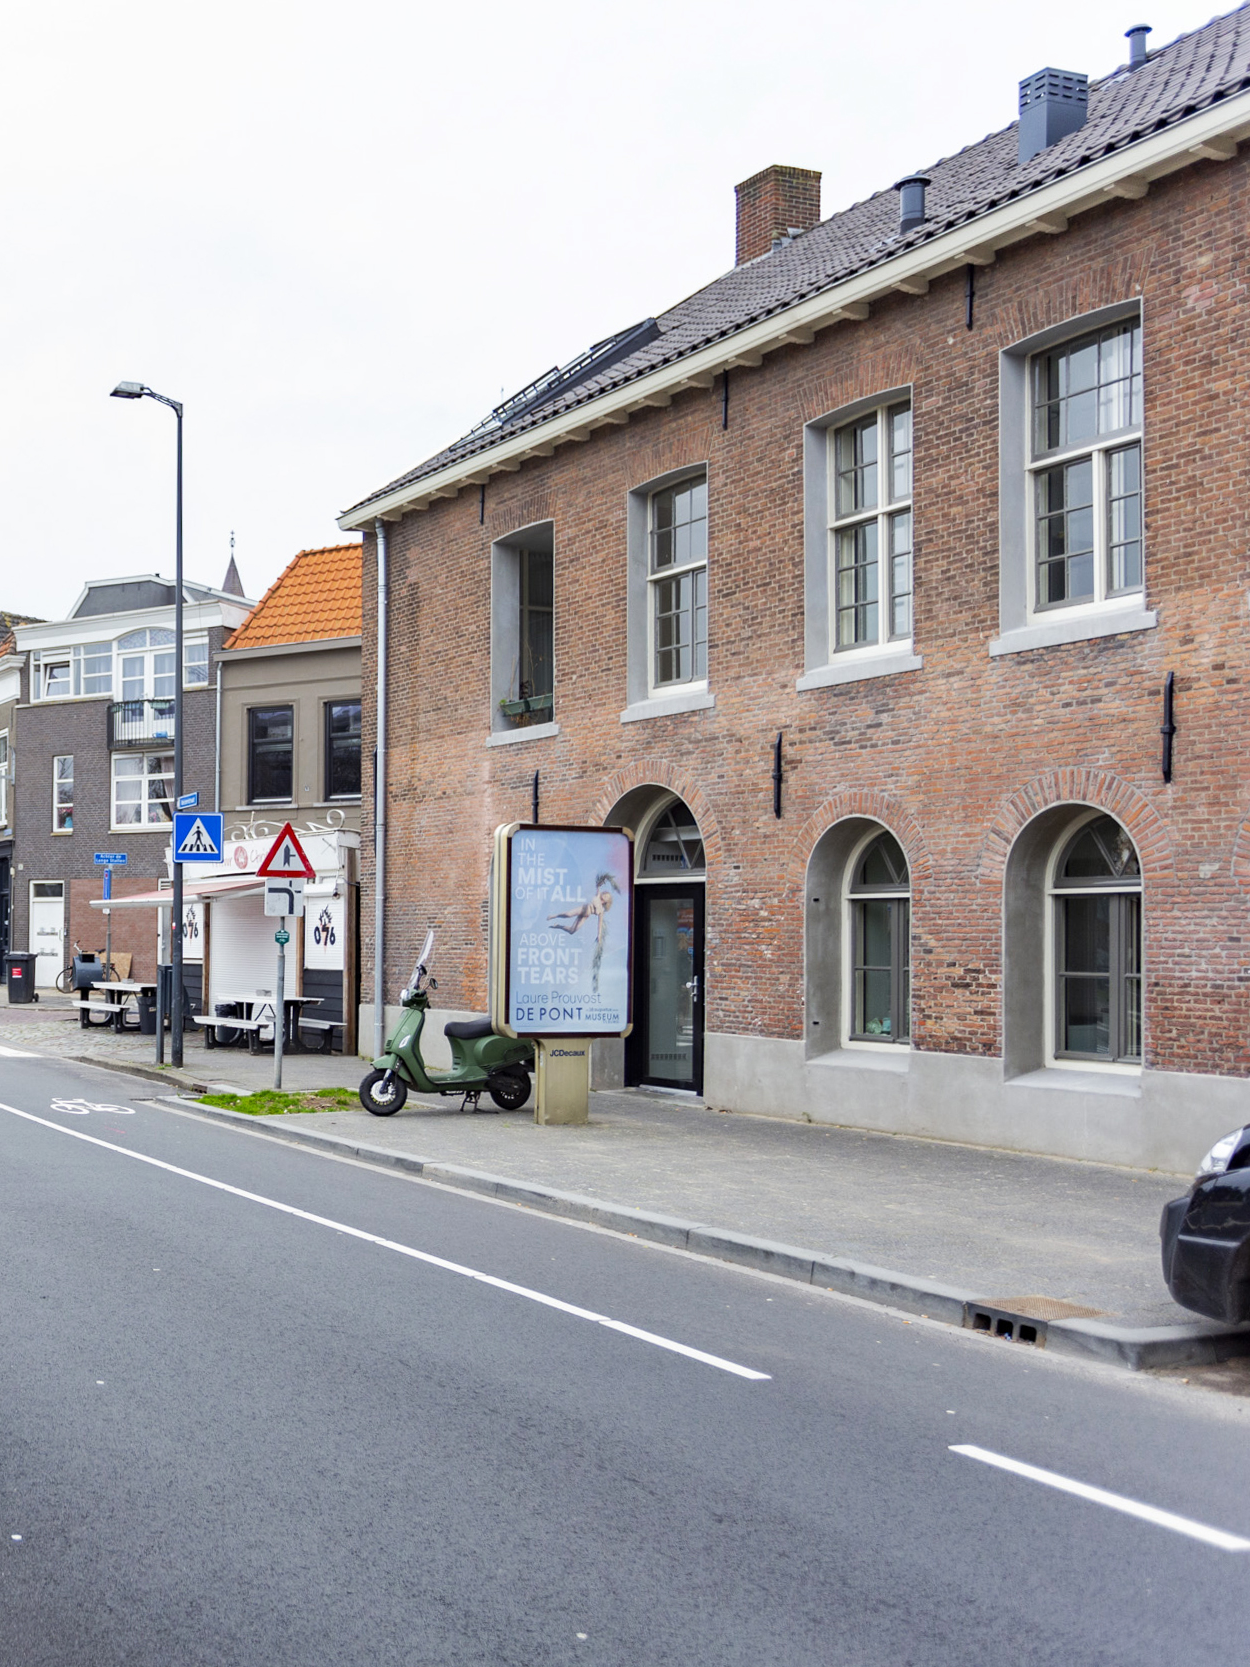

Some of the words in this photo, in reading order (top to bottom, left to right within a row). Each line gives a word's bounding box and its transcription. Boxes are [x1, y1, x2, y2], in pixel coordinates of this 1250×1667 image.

[520, 838, 536, 851] IN
[517, 853, 545, 867] THE
[518, 867, 568, 886] MIST
[515, 886, 534, 900] OF
[537, 886, 550, 900] IT
[550, 885, 587, 903] ALL
[519, 933, 566, 947] ABOVE
[517, 947, 583, 966] FRONT
[517, 967, 579, 985] TEARS
[516, 991, 549, 1005] Laure
[551, 991, 602, 1004] Prouvost
[516, 1007, 534, 1021] DE
[539, 1007, 583, 1021] PONT
[585, 1013, 620, 1021] MUSEUM
[550, 1049, 586, 1057] JCDecaux
